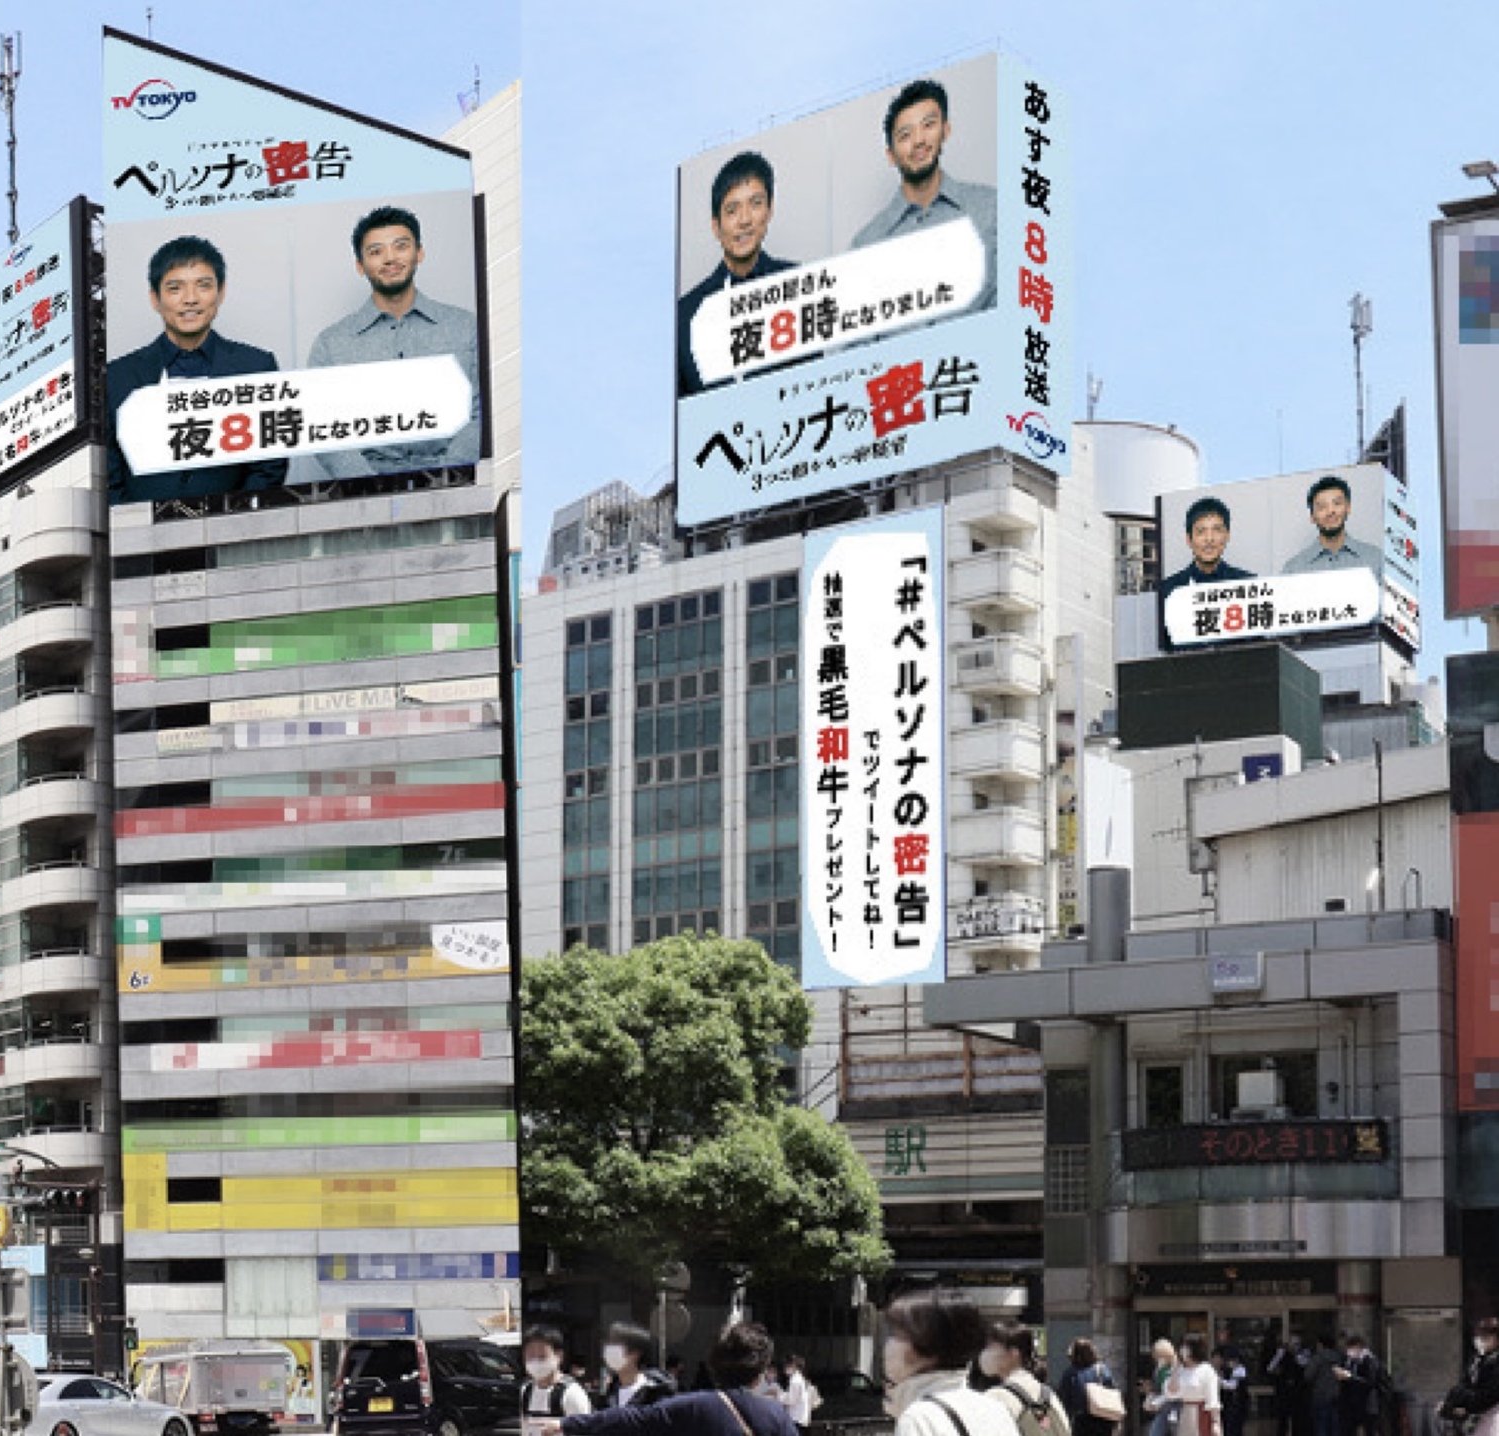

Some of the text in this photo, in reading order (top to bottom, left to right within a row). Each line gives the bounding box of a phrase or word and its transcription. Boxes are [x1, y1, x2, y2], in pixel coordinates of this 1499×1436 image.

[111, 89, 198, 110] TV TOKYO
[113, 140, 353, 198] ペルソナの密告
[1018, 80, 1054, 406] あす夜8時放送
[730, 269, 837, 318] 渋谷の皆さん
[729, 281, 954, 366] 夜8時になりました
[166, 380, 300, 414] 渋谷の皆さん
[693, 355, 981, 475] ペルソナの密告
[167, 406, 438, 461] 夜8時になりました
[892, 555, 930, 950] 「#ペルソナの密告」
[883, 1124, 928, 1176] 駅
